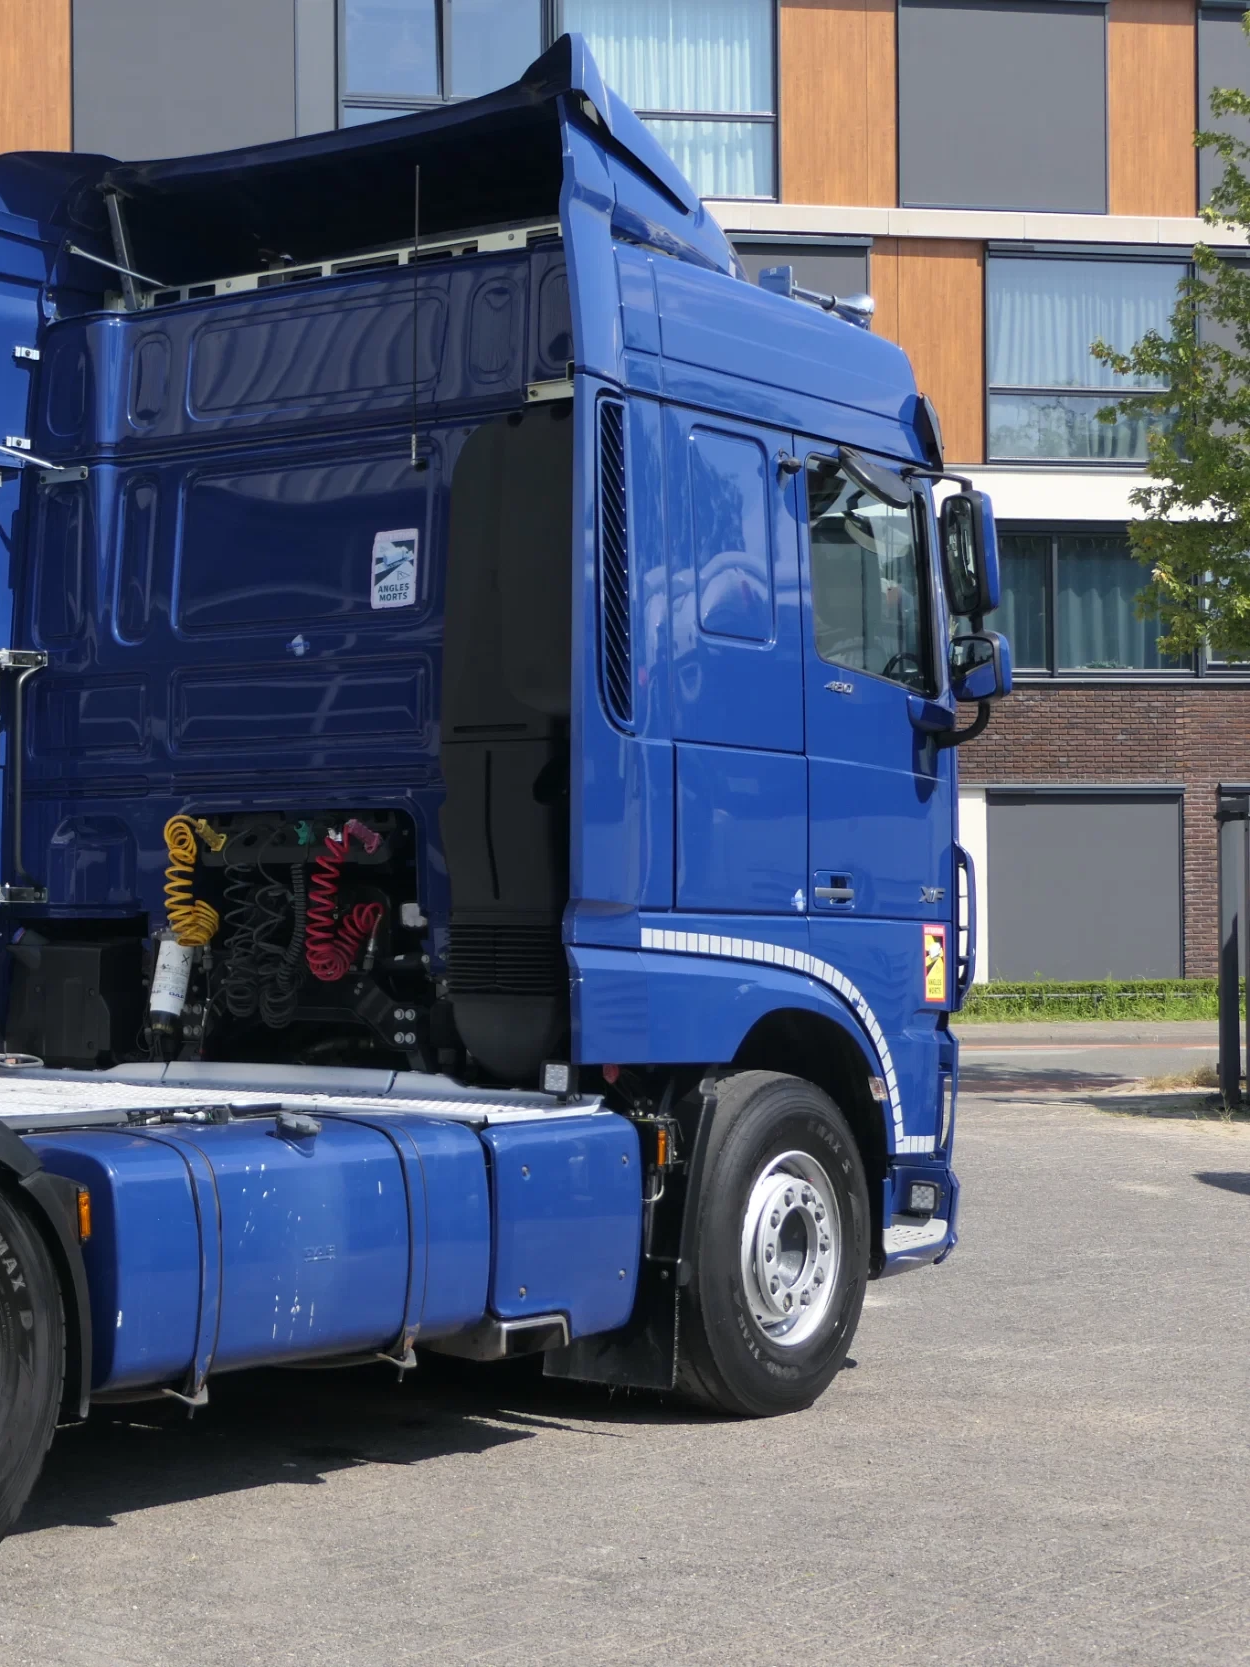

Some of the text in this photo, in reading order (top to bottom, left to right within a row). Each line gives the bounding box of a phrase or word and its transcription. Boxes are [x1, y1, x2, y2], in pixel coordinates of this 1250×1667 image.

[378, 583, 410, 593] ANGLES
[379, 592, 408, 602] MORTS
[824, 681, 853, 693] 480
[919, 886, 946, 903] XF
[18, 1310, 34, 1331] D
